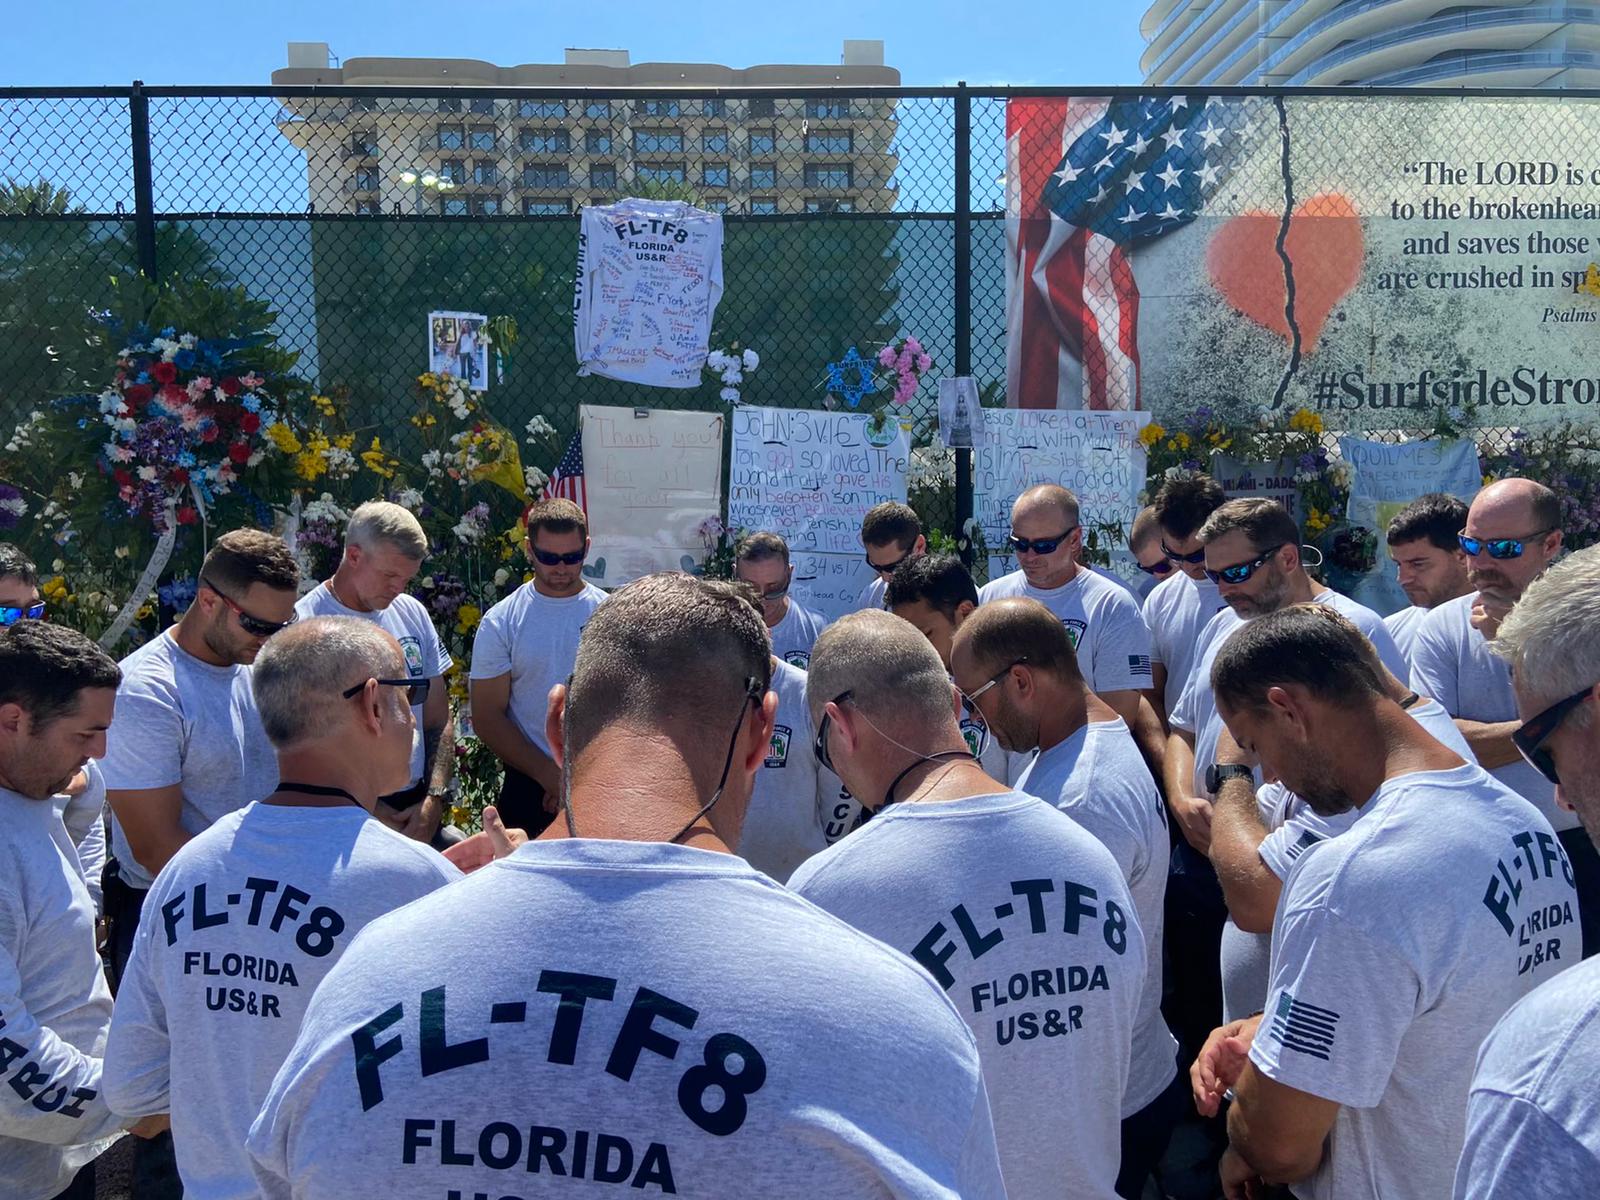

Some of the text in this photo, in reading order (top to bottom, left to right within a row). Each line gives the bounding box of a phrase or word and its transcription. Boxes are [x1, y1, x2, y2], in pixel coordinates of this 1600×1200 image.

[1403, 161, 1468, 186] “The
[1476, 161, 1558, 186] LORD
[1566, 162, 1584, 186] is
[1391, 199, 1415, 221] to
[1422, 197, 1461, 221] the
[614, 218, 689, 244] FL-TF8
[1403, 231, 1449, 255] and
[1458, 237, 1520, 255] saves
[1528, 231, 1589, 254] those
[628, 241, 674, 253] FLORIDA
[636, 253, 666, 263] US&R
[1379, 272, 1418, 290] are
[1426, 265, 1523, 289] crushed
[1532, 265, 1554, 288] in
[1542, 307, 1597, 323] Psalms
[1313, 367, 1600, 410] #SurfsideStro
[594, 417, 712, 460] Thank you
[985, 427, 1000, 446] nd
[830, 448, 870, 474] loved
[870, 448, 907, 474] The
[1352, 444, 1442, 466] QUILMES
[659, 464, 689, 488] all
[833, 472, 867, 496] gave
[975, 470, 1008, 490] not
[730, 485, 761, 505] only
[775, 516, 801, 528] not
[161, 877, 345, 958] FL-TF8
[911, 878, 1127, 992] FL-TF8
[184, 952, 299, 987] FLORIDA
[971, 964, 1110, 1013] FLORIDA
[206, 986, 282, 1019] US&R
[996, 1004, 1084, 1046] US&R
[351, 969, 767, 1137] FL-TF8
[402, 1118, 677, 1195] FLORIDA
